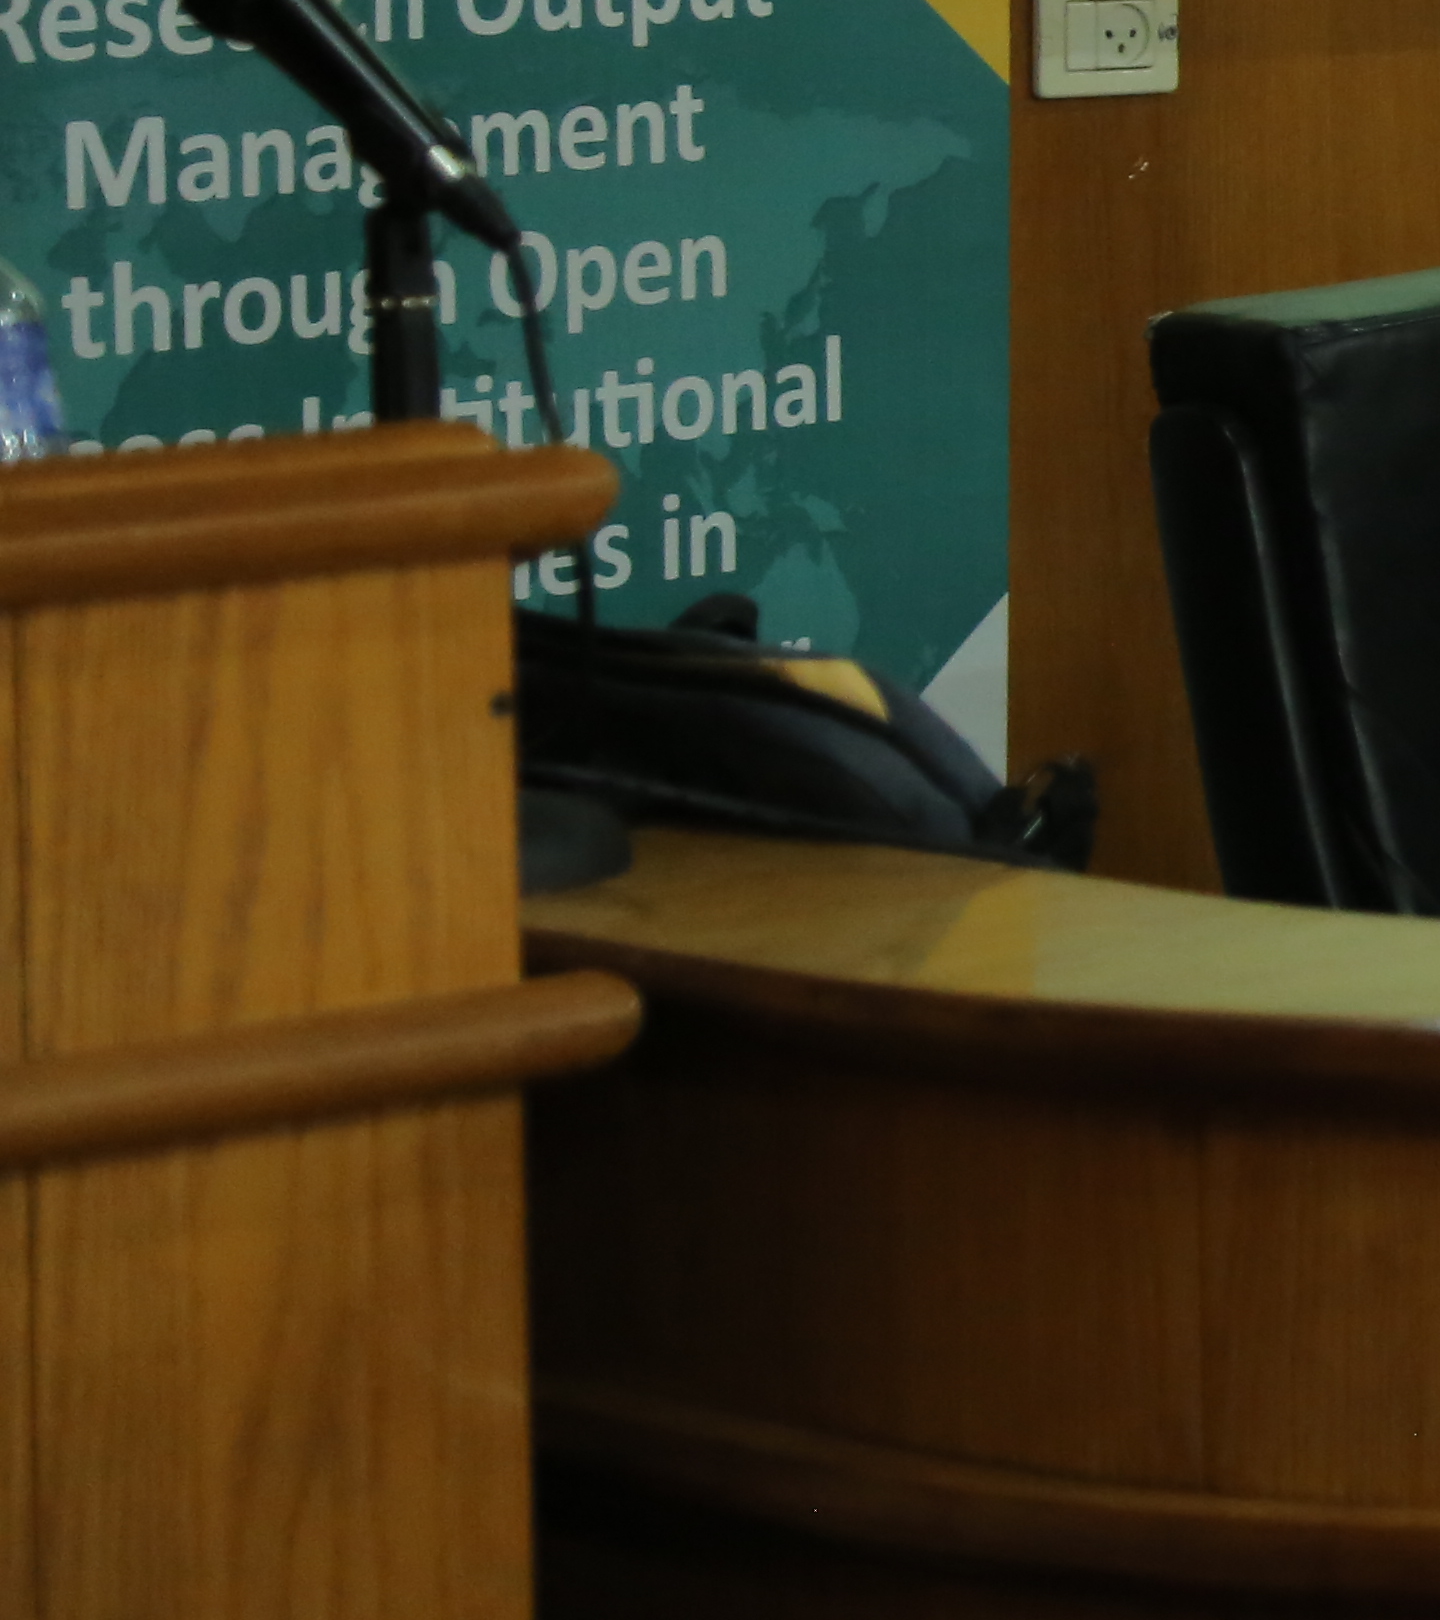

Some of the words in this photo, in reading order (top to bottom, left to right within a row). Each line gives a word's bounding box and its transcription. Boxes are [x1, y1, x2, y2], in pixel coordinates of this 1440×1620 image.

[64, 84, 707, 210] Manament
[488, 232, 729, 333] Open
[660, 493, 737, 580] in
